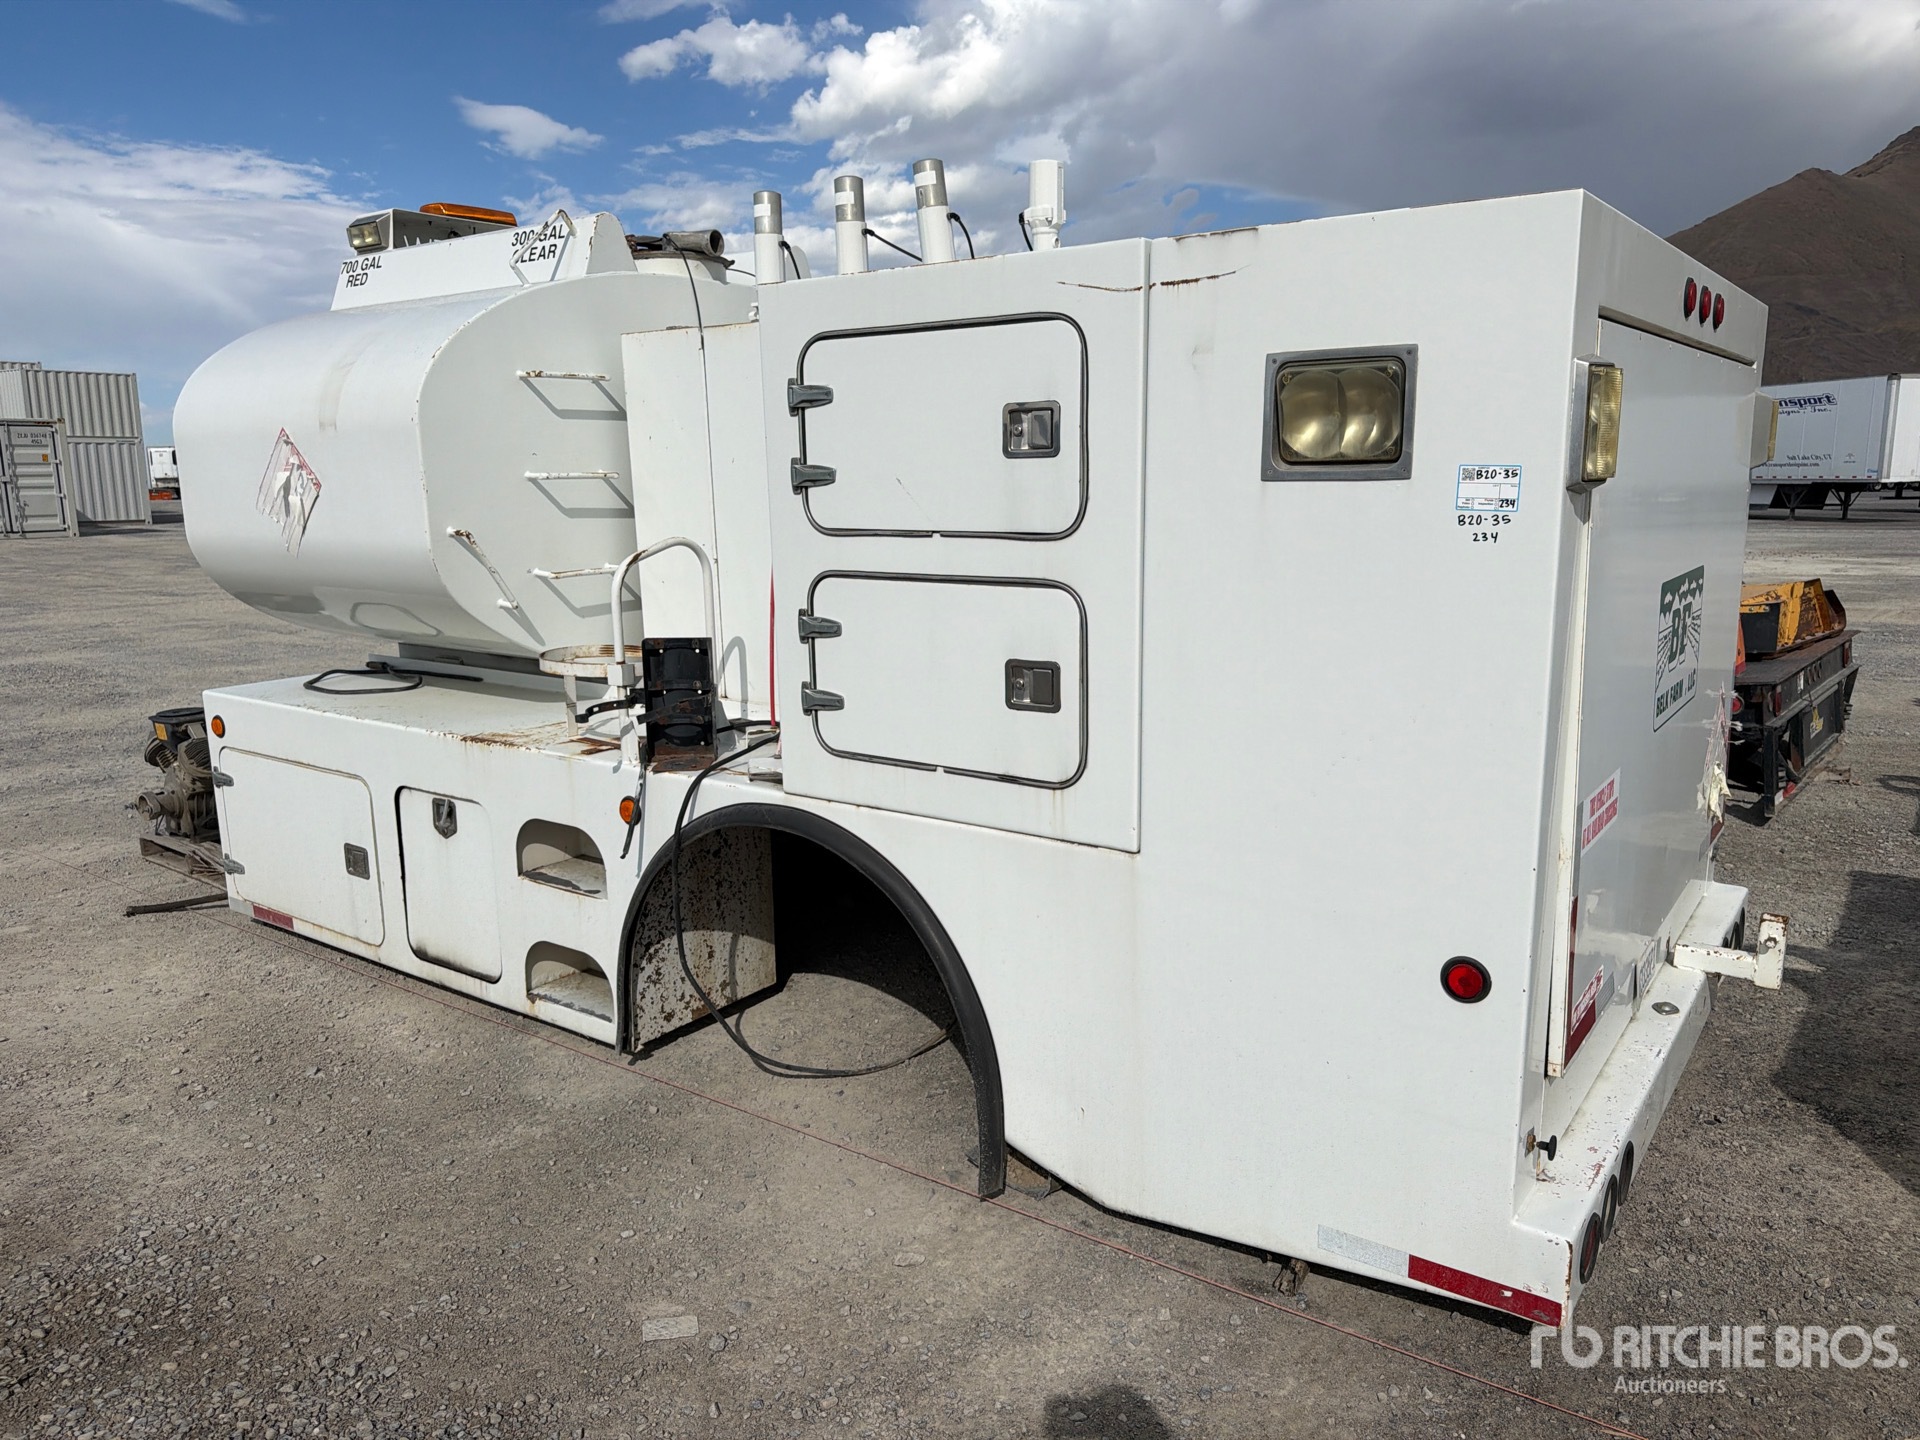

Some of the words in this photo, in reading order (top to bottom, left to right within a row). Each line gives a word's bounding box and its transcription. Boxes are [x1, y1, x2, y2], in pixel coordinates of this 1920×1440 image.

[536, 224, 565, 242] GAL
[341, 259, 359, 275] 700
[360, 255, 382, 271] GAL
[346, 272, 369, 288] RED
[1499, 499, 1516, 509] 234
[1472, 532, 1499, 543] 234
[1656, 689, 1670, 718] BELK
[1688, 668, 1696, 692] LLC
